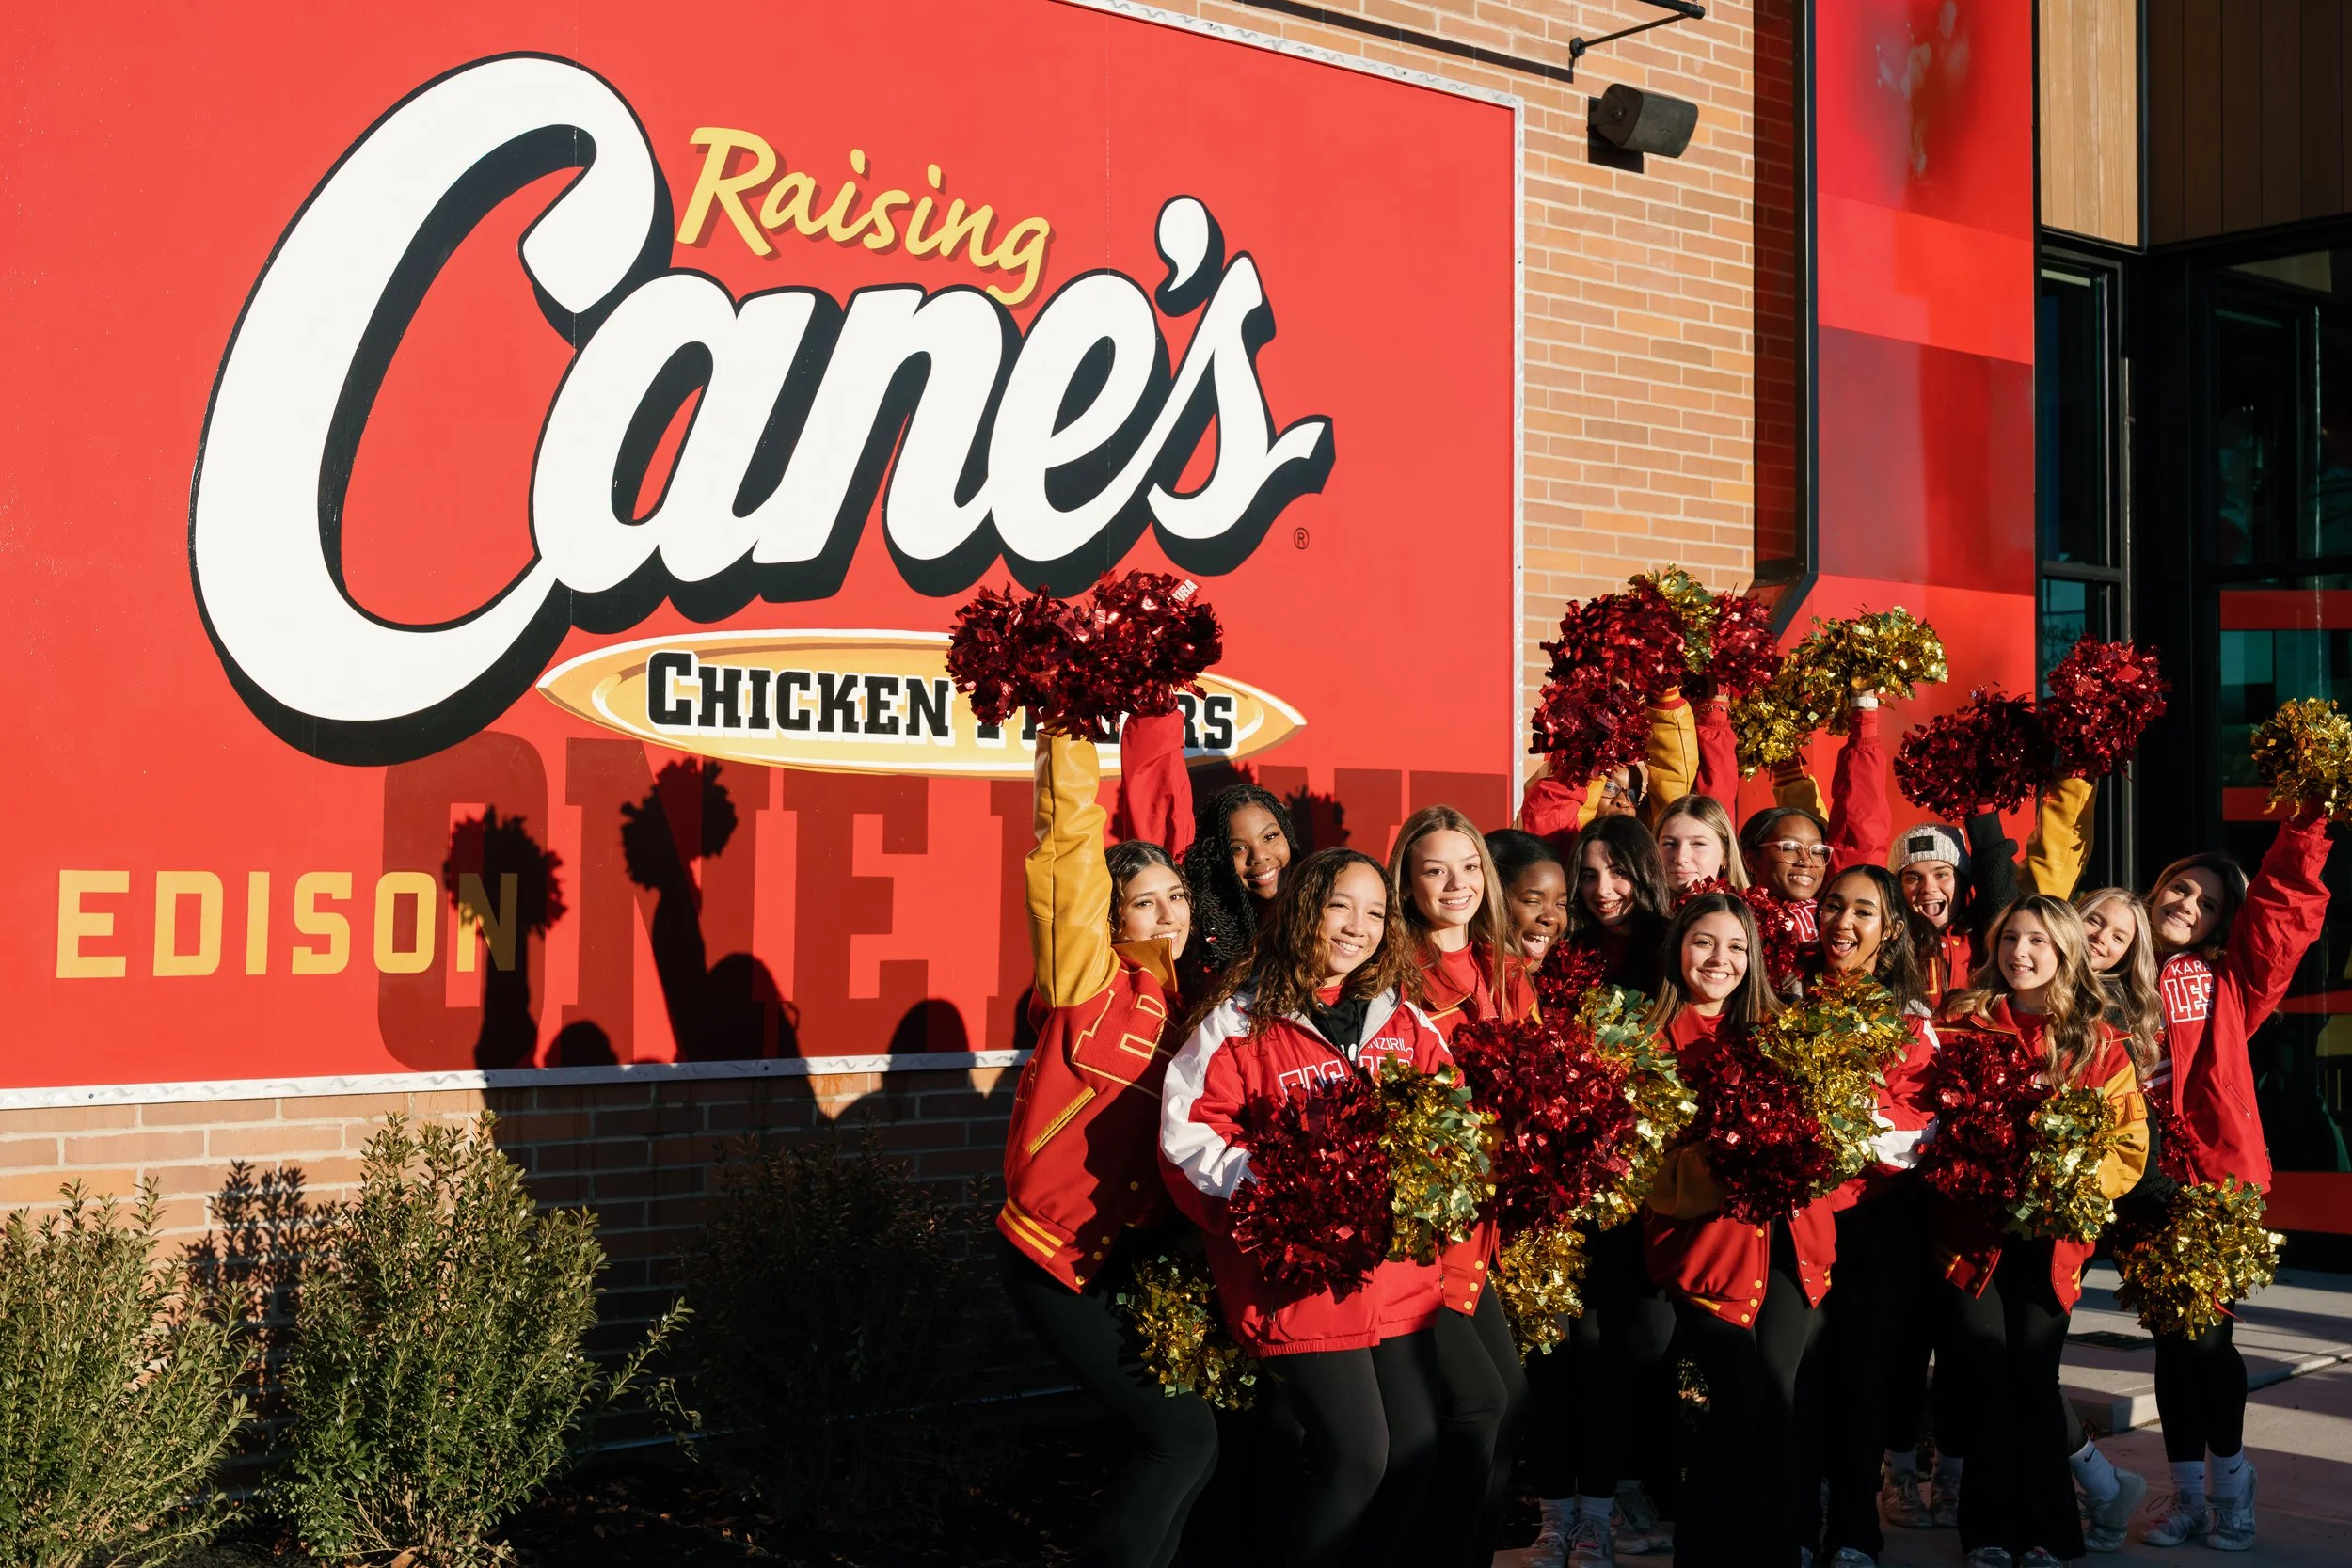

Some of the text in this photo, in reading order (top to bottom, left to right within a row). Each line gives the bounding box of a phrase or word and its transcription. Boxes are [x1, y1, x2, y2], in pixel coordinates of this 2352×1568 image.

[675, 126, 1052, 306] Raising
[189, 51, 1336, 766] Cane's
[647, 650, 951, 738] CHICKEN
[56, 869, 519, 979] EDISON
